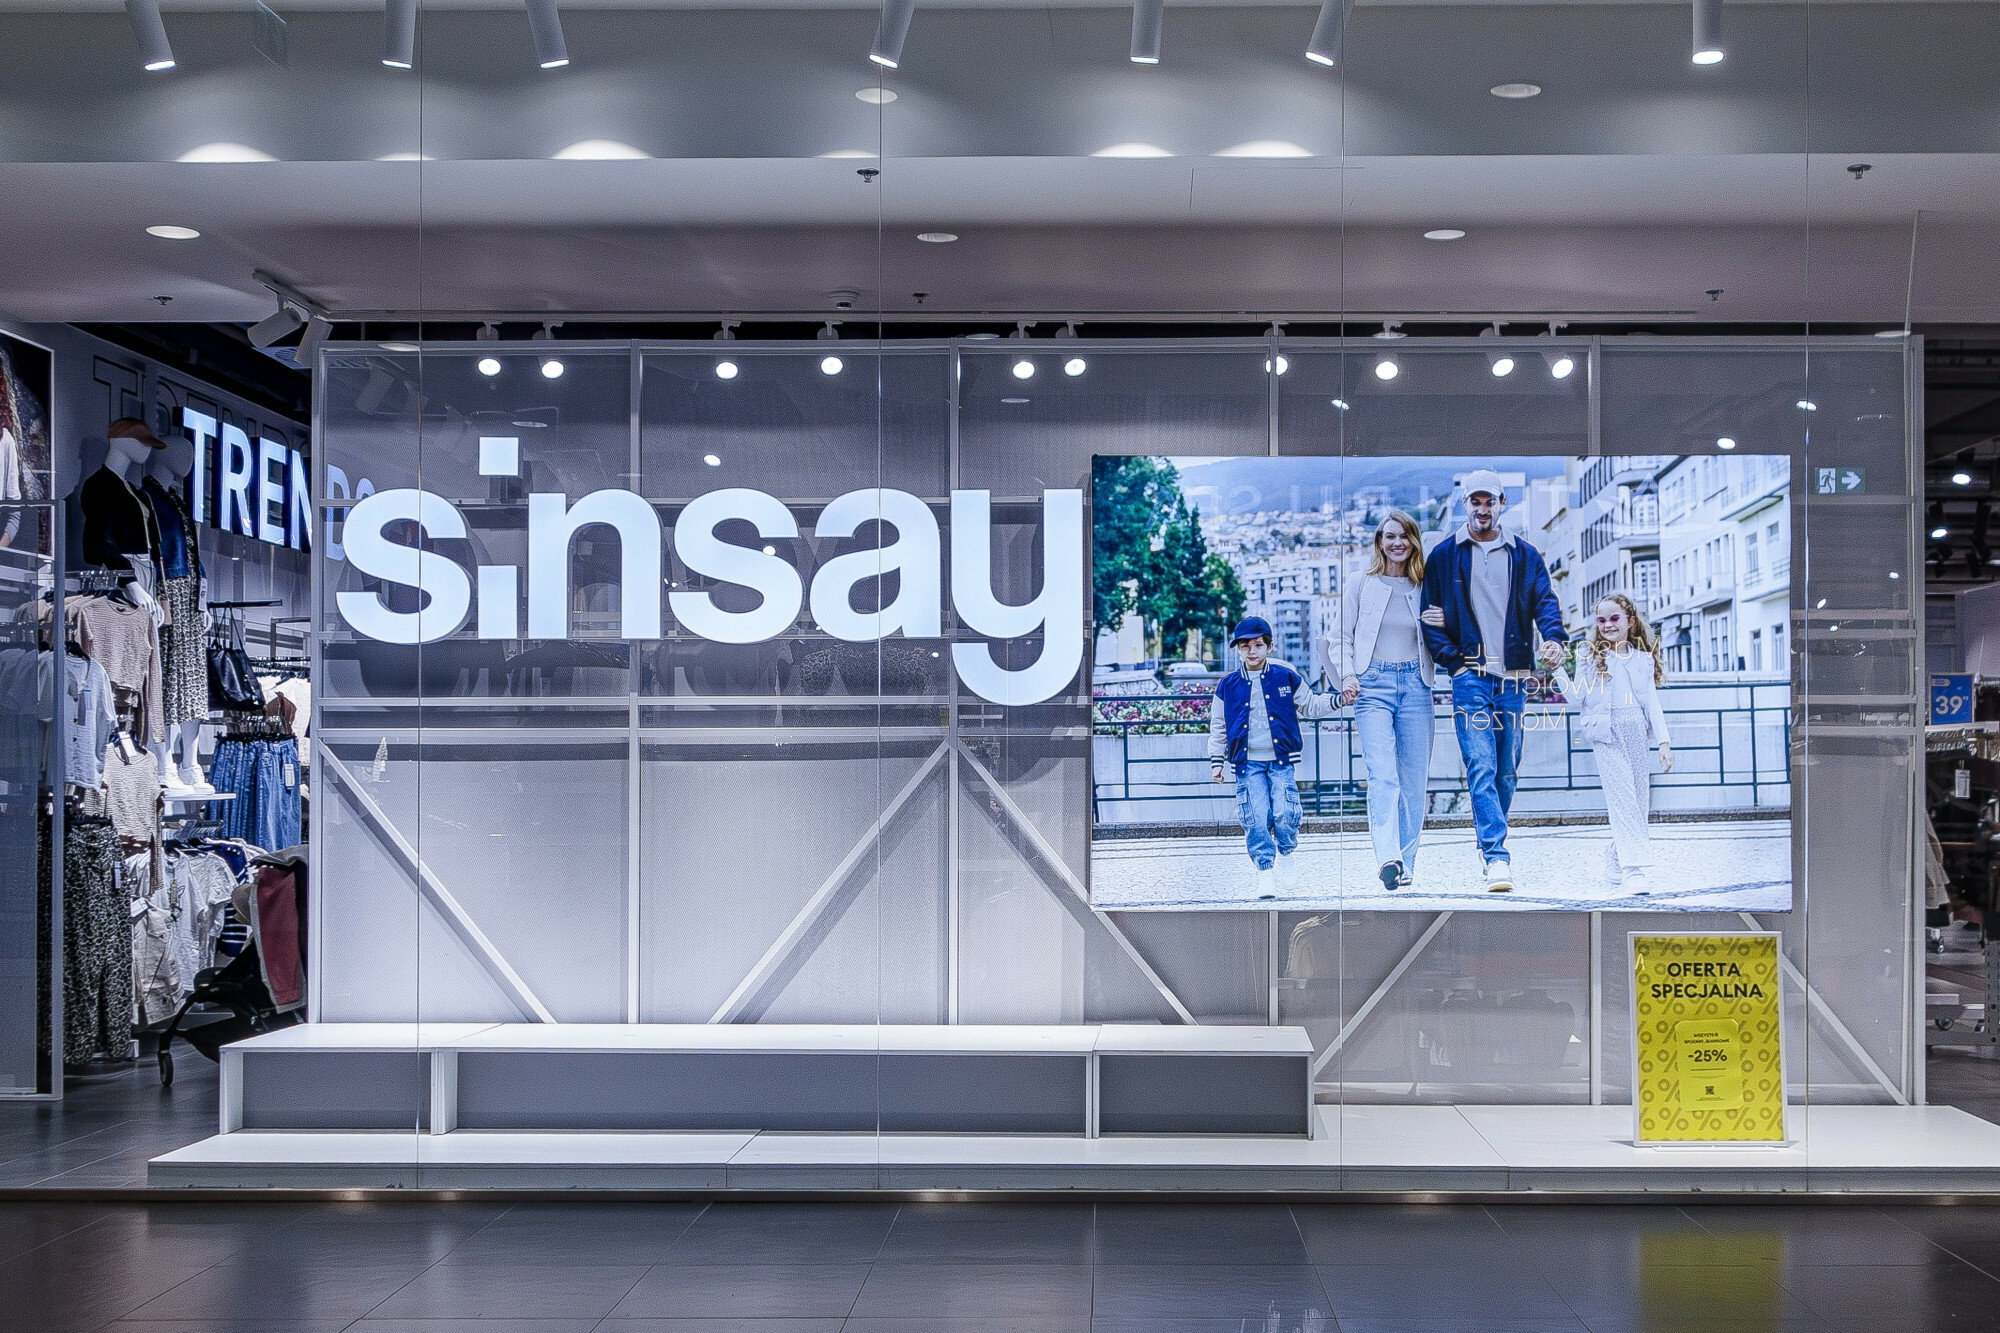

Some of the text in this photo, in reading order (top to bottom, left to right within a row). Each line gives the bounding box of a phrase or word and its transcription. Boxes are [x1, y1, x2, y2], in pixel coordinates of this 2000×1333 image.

[336, 436, 1084, 706] sinsay
[1667, 962, 1741, 978] OFERTA
[1651, 983, 1764, 999] SPECJALNA
[1688, 1049, 1728, 1062] -25%
